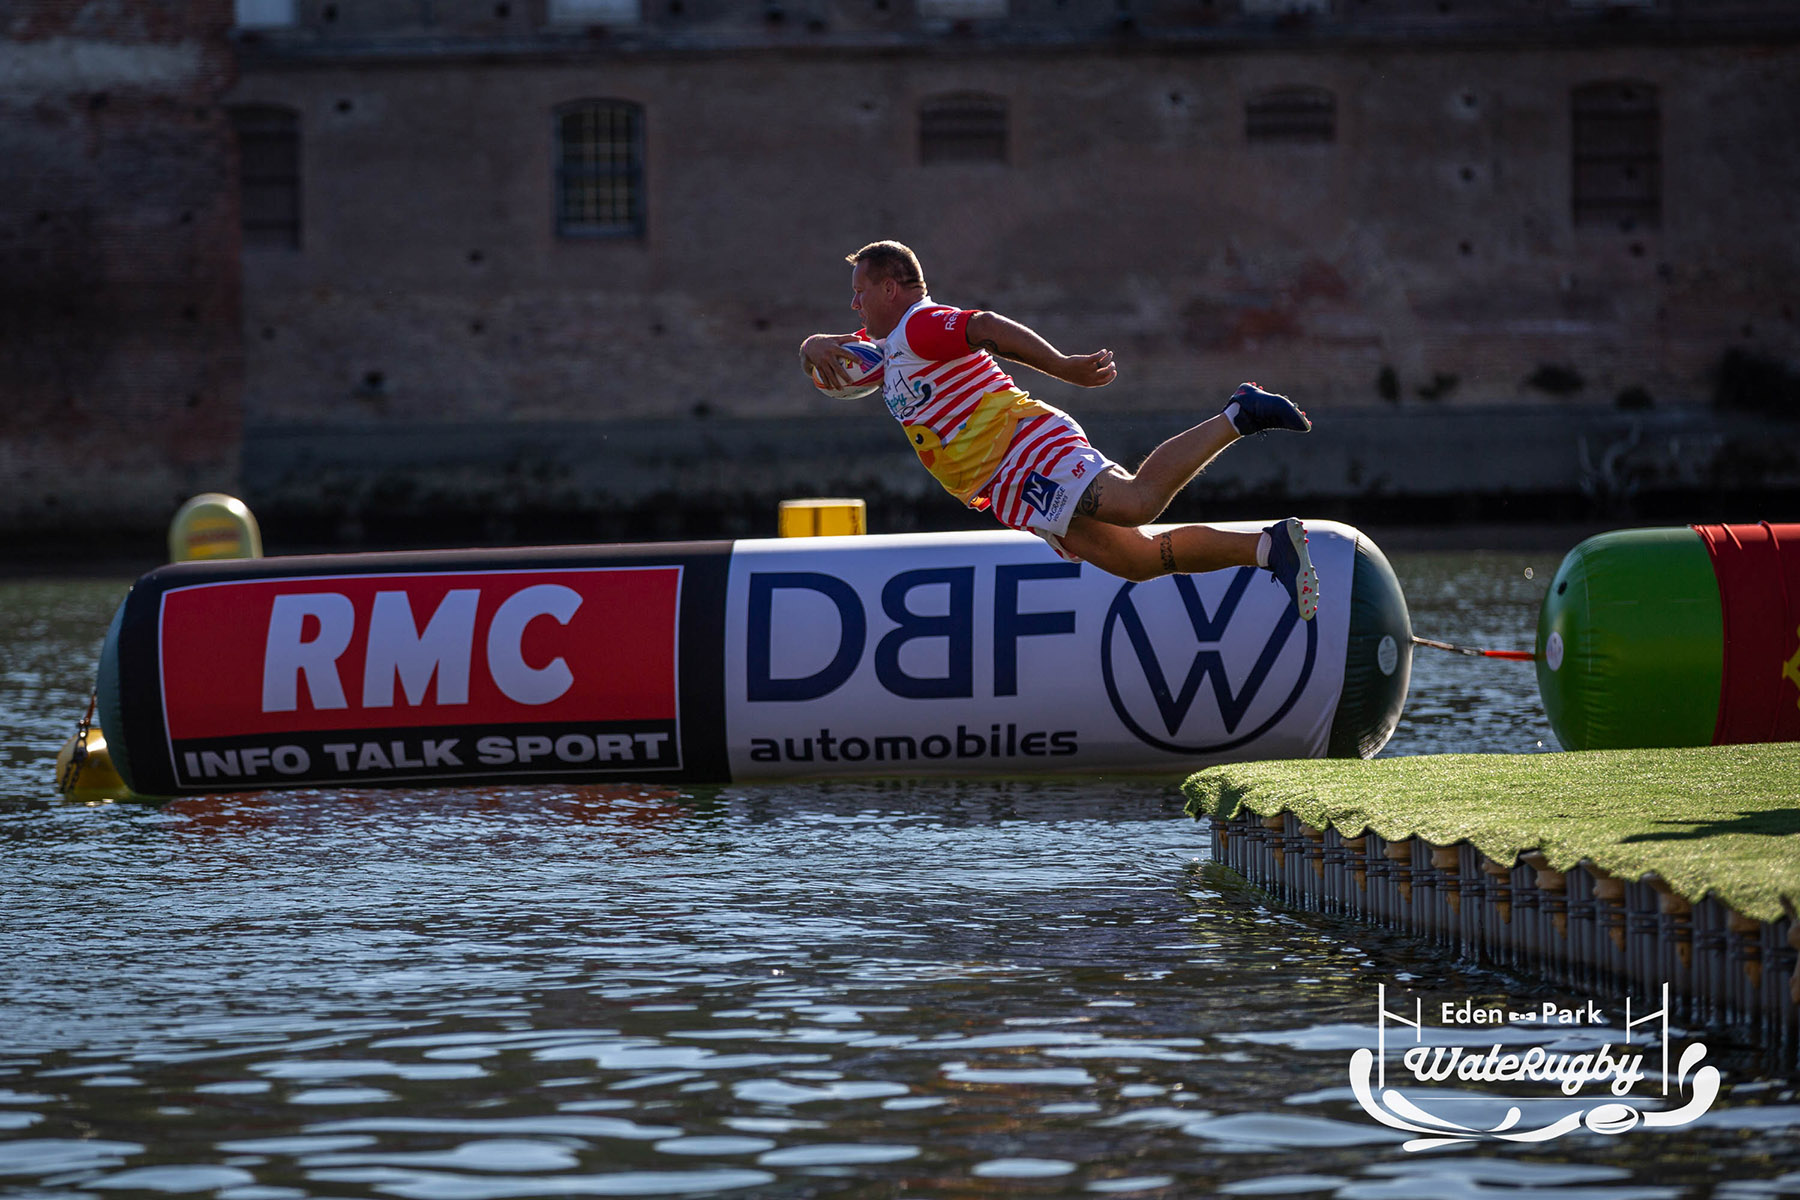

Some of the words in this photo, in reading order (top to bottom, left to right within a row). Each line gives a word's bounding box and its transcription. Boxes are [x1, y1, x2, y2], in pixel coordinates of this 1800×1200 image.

[1046, 486, 1065, 522] LAGRANGE
[262, 584, 584, 712] RMC
[747, 562, 1082, 704] DBF
[185, 745, 310, 778] INFO
[324, 739, 460, 772] TALK
[477, 733, 669, 765] SPORT
[750, 723, 1079, 762] automobiles
